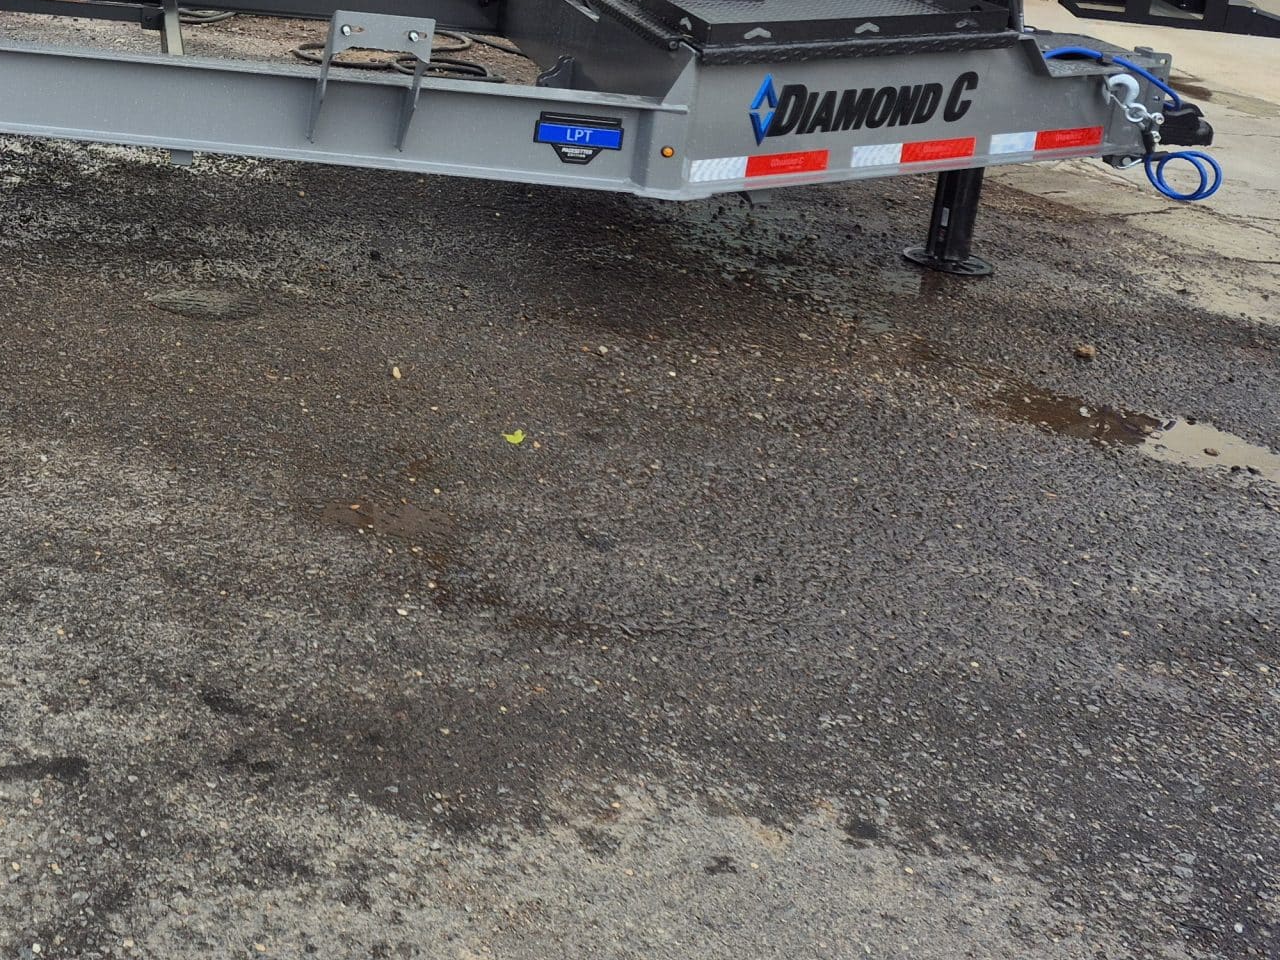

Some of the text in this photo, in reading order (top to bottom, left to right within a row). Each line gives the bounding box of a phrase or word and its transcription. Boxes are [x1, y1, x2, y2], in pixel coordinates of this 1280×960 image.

[766, 71, 979, 137] DIAMOND C
[566, 128, 593, 143] LPT
